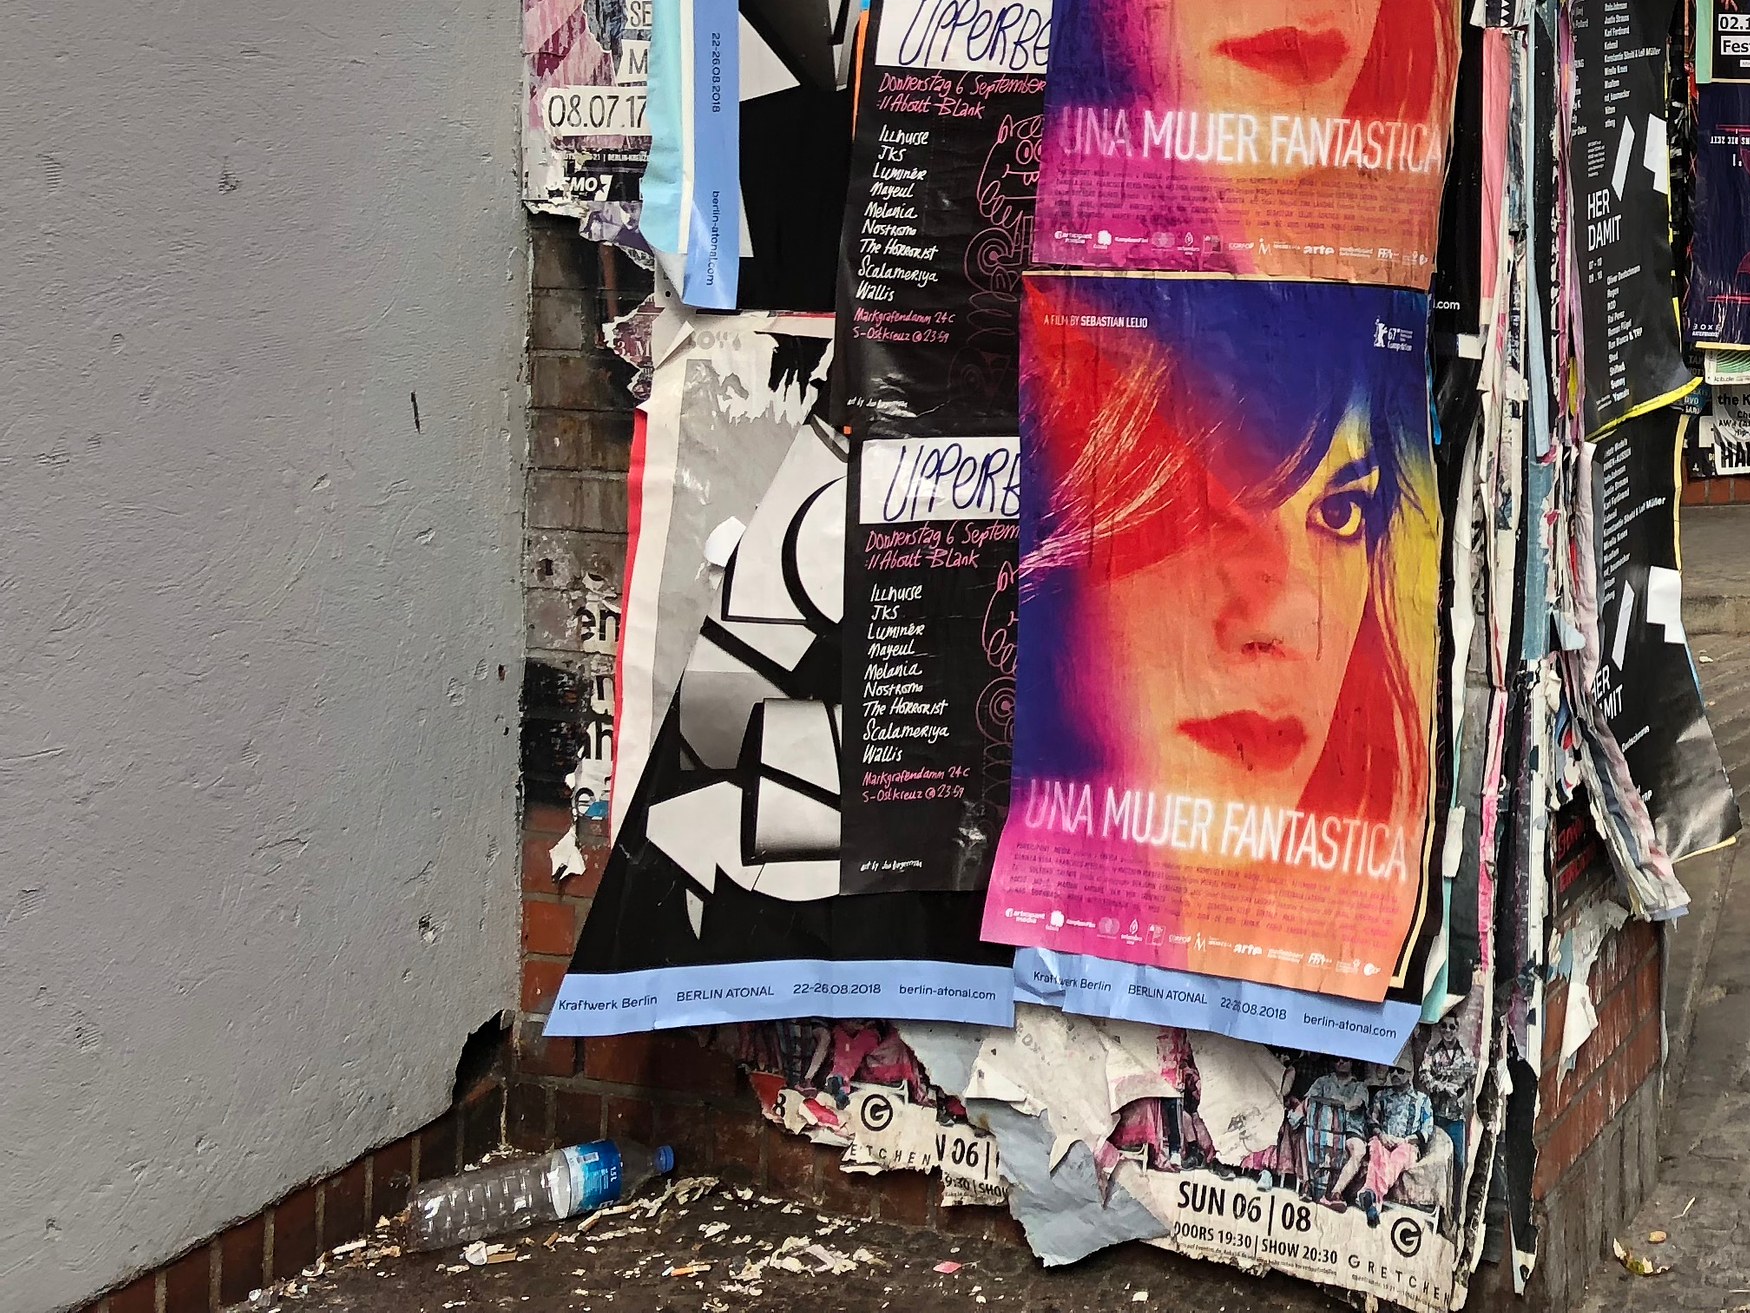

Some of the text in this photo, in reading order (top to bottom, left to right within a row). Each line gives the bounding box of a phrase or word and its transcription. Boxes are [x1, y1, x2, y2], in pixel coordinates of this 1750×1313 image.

[548, 94, 647, 128] 08.07.17
[1062, 106, 1442, 174] UNA MUJER FANTASTICA
[1588, 189, 1610, 220] HER
[706, 191, 720, 286] berlin-atonal.com
[1303, 244, 1334, 256] arte
[1588, 215, 1621, 251] DAMIT
[1081, 316, 1124, 327] SEBASTIAN
[1126, 318, 1148, 328] LELIO
[1024, 778, 1407, 882] UNA MUJER FANTASTICA
[558, 998, 617, 1012] Kraftwerk
[622, 994, 657, 1008] Berlin
[677, 990, 722, 1002] BERLIN
[726, 986, 774, 998] ATONAL
[899, 984, 996, 1001] berlin-atonal.com
[1177, 1181, 1225, 1216] SUN
[1174, 1222, 1214, 1242] DOORS
[1218, 1231, 1251, 1248] 19:30
[1261, 1238, 1300, 1259] SHOW
[1302, 1247, 1338, 1264] 20:30
[1349, 1254, 1450, 1305] GRETCHEN
